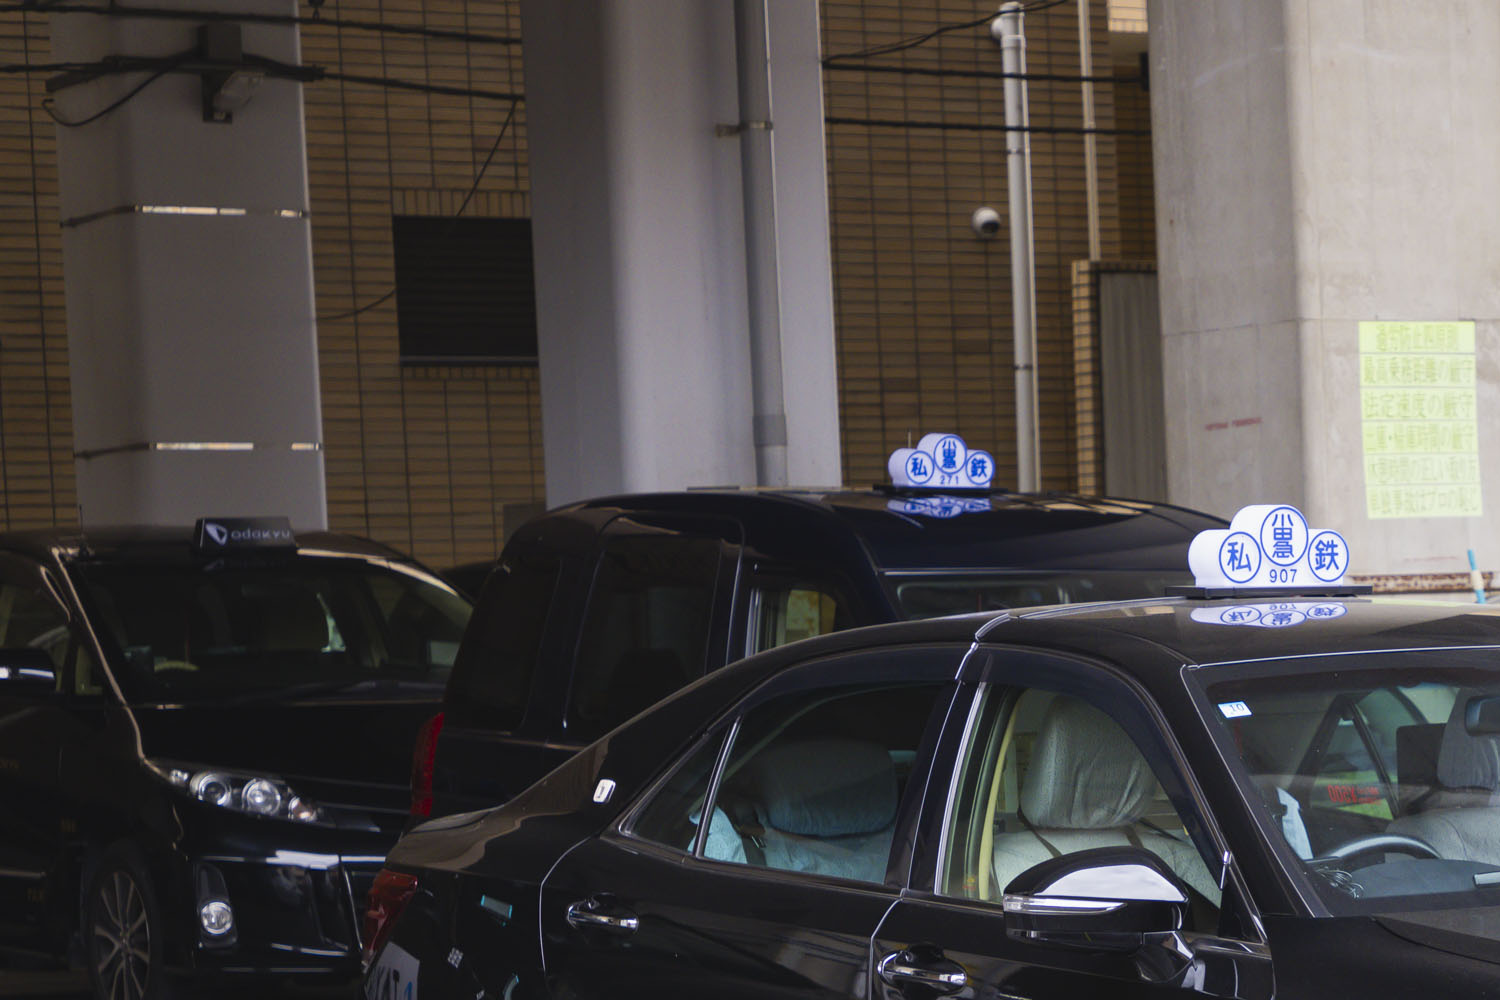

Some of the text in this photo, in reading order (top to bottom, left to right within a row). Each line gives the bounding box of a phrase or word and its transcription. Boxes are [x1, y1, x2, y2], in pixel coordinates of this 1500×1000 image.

[911, 457, 928, 477] 私
[971, 458, 987, 478] 鉄
[231, 528, 290, 540] odakyu
[1227, 541, 1252, 572] 私
[1314, 540, 1339, 571] 鉄
[1269, 569, 1298, 583] 907
